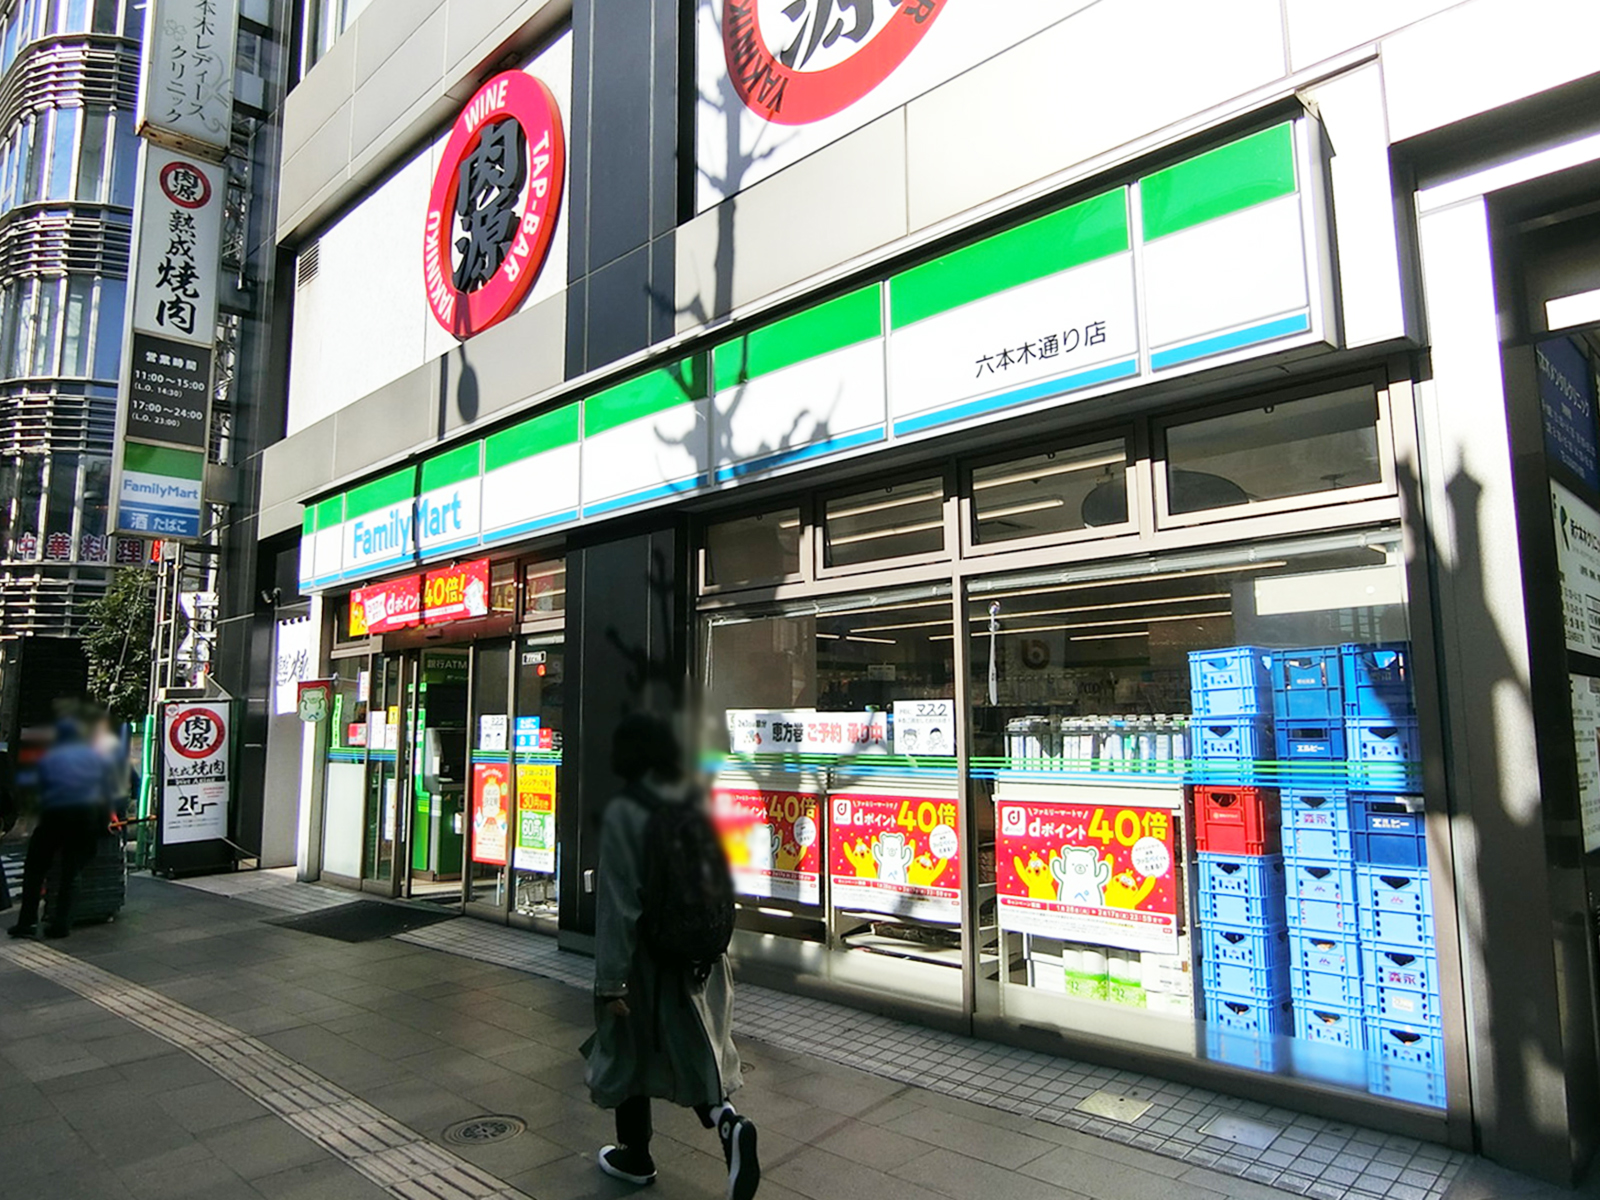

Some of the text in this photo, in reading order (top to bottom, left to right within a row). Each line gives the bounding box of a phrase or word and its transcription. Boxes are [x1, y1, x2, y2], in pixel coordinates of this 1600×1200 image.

[165, 44, 188, 124] クリニック
[464, 79, 509, 134] WINE
[171, 169, 198, 202] 肉源
[452, 117, 526, 294] 肉源
[502, 130, 550, 283] TAP-BAR
[156, 208, 200, 335] 熟成焼肉
[146, 352, 197, 372] 営業時間
[975, 320, 1106, 379] 六本木通り店
[123, 479, 199, 500] FamilyMart
[131, 512, 188, 534] 酒 たばこ
[353, 491, 461, 558] FamilyMart
[16, 531, 143, 563] 中華料理
[424, 573, 465, 607] 40倍!
[916, 703, 947, 716] マスク
[184, 716, 212, 750] 肉源
[772, 722, 804, 743] 恵方巻
[807, 722, 842, 744] ご予約
[847, 723, 883, 745] 承り中
[178, 795, 198, 812] 2F
[769, 795, 816, 823] 40倍
[853, 800, 957, 833] dポイント 40倍
[1028, 808, 1168, 847] dポイント 40倍
